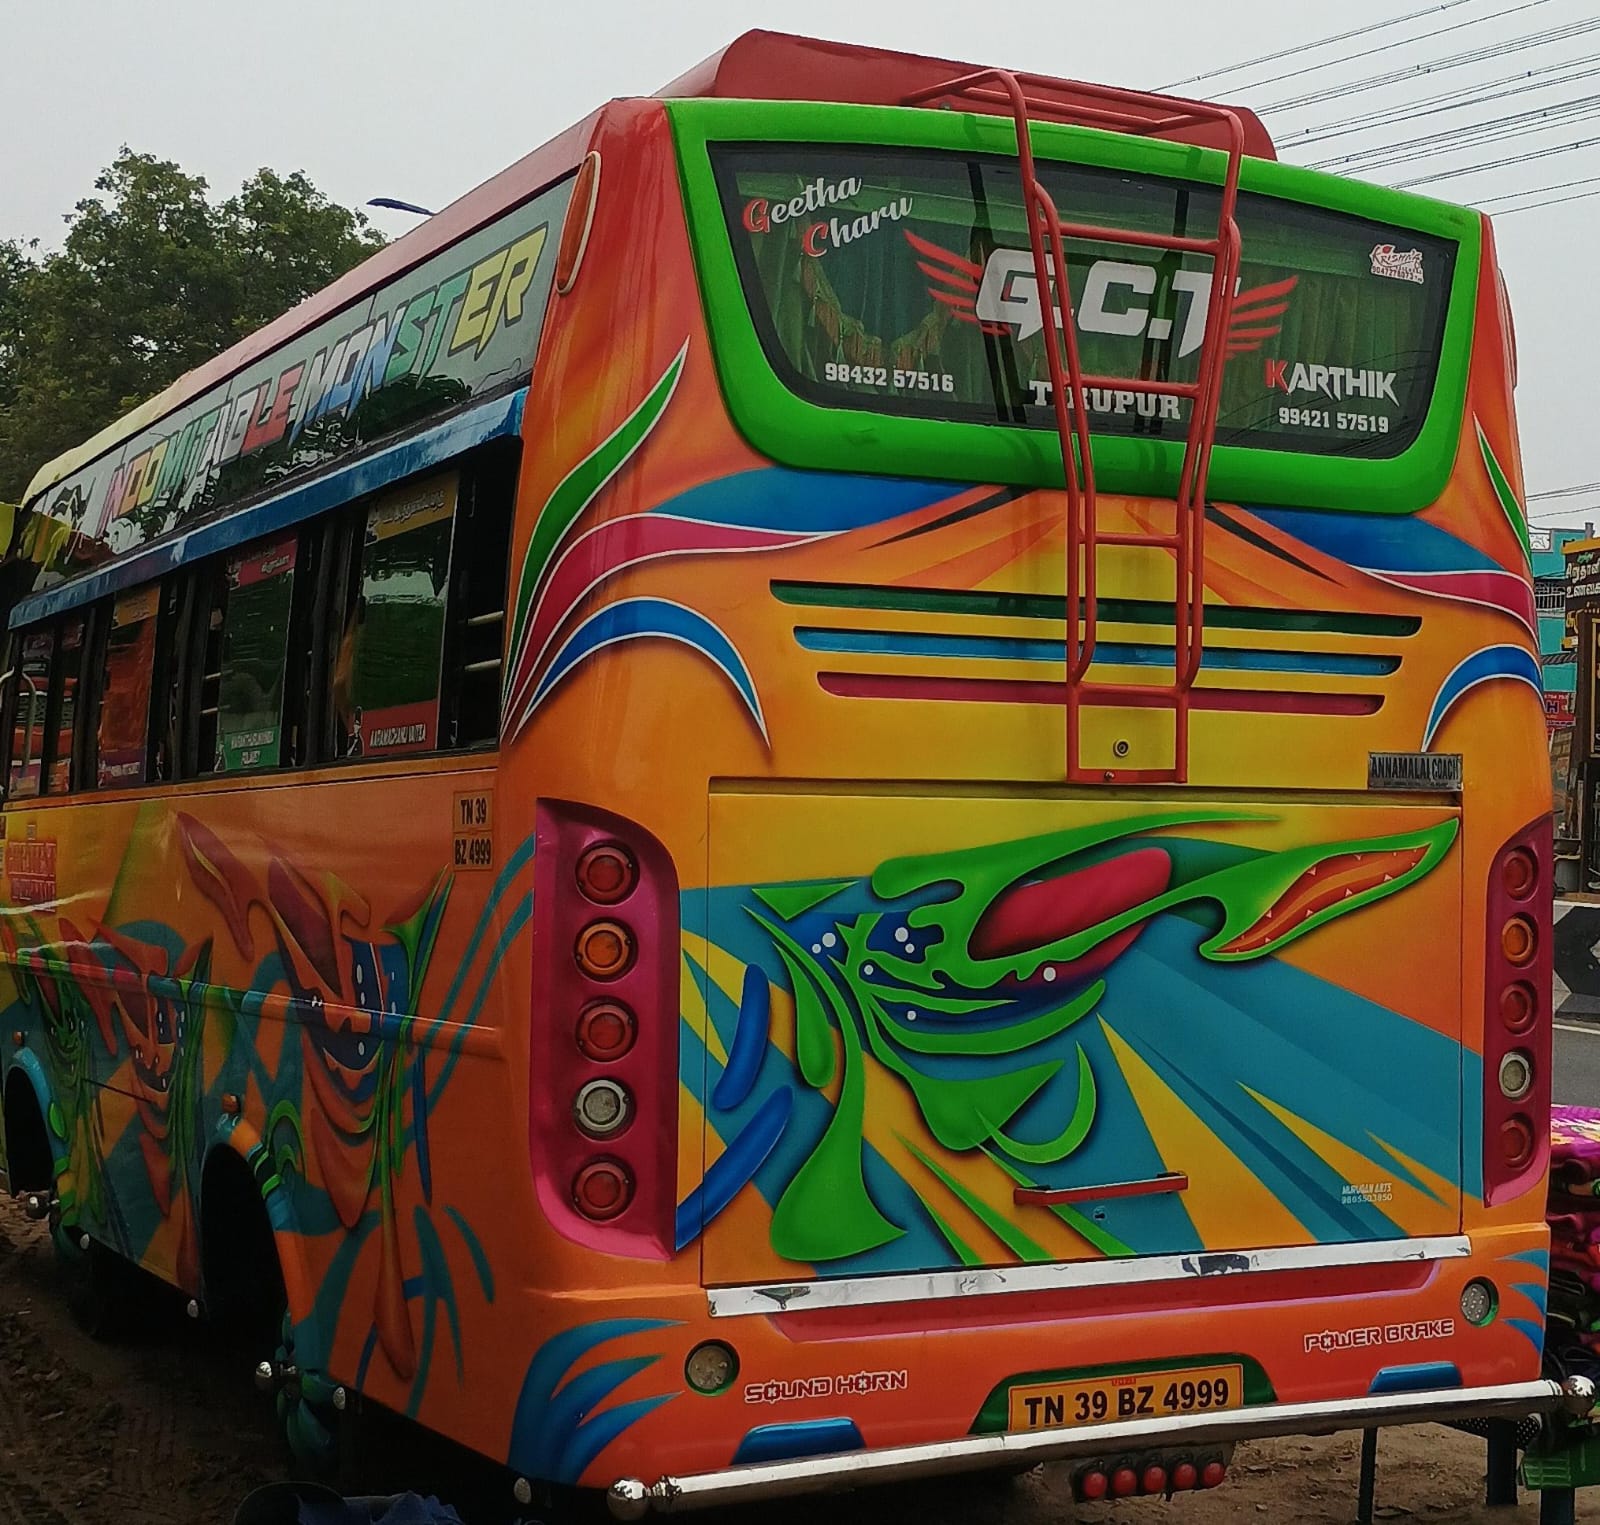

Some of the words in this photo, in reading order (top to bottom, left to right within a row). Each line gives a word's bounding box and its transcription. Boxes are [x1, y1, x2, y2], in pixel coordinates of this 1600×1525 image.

[741, 176, 862, 233] Geetha
[803, 196, 913, 257] Charu
[287, 221, 549, 450] MONSTER
[824, 362, 887, 387] 98432
[893, 370, 954, 392] 57516
[1264, 358, 1400, 407] KARTHIK
[1029, 380, 1181, 420] TRUPUR
[1279, 407, 1330, 428] 99421
[1336, 412, 1389, 433] 57519
[1371, 757, 1430, 779] ANNAMALAI
[1432, 759, 1459, 780] COACH
[460, 799, 473, 824] TN
[475, 797, 487, 824] 39
[455, 839, 467, 865] BZ
[469, 838, 491, 865] 4999
[1304, 1329, 1382, 1353] POWER
[1384, 1318, 1455, 1343] BRAKE
[744, 1379, 833, 1404] SOUND
[835, 1369, 908, 1395] HORN
[1025, 1394, 1064, 1426] TN
[1074, 1389, 1108, 1421] 39
[1118, 1385, 1154, 1416] BZ
[1163, 1377, 1229, 1411] 4999
